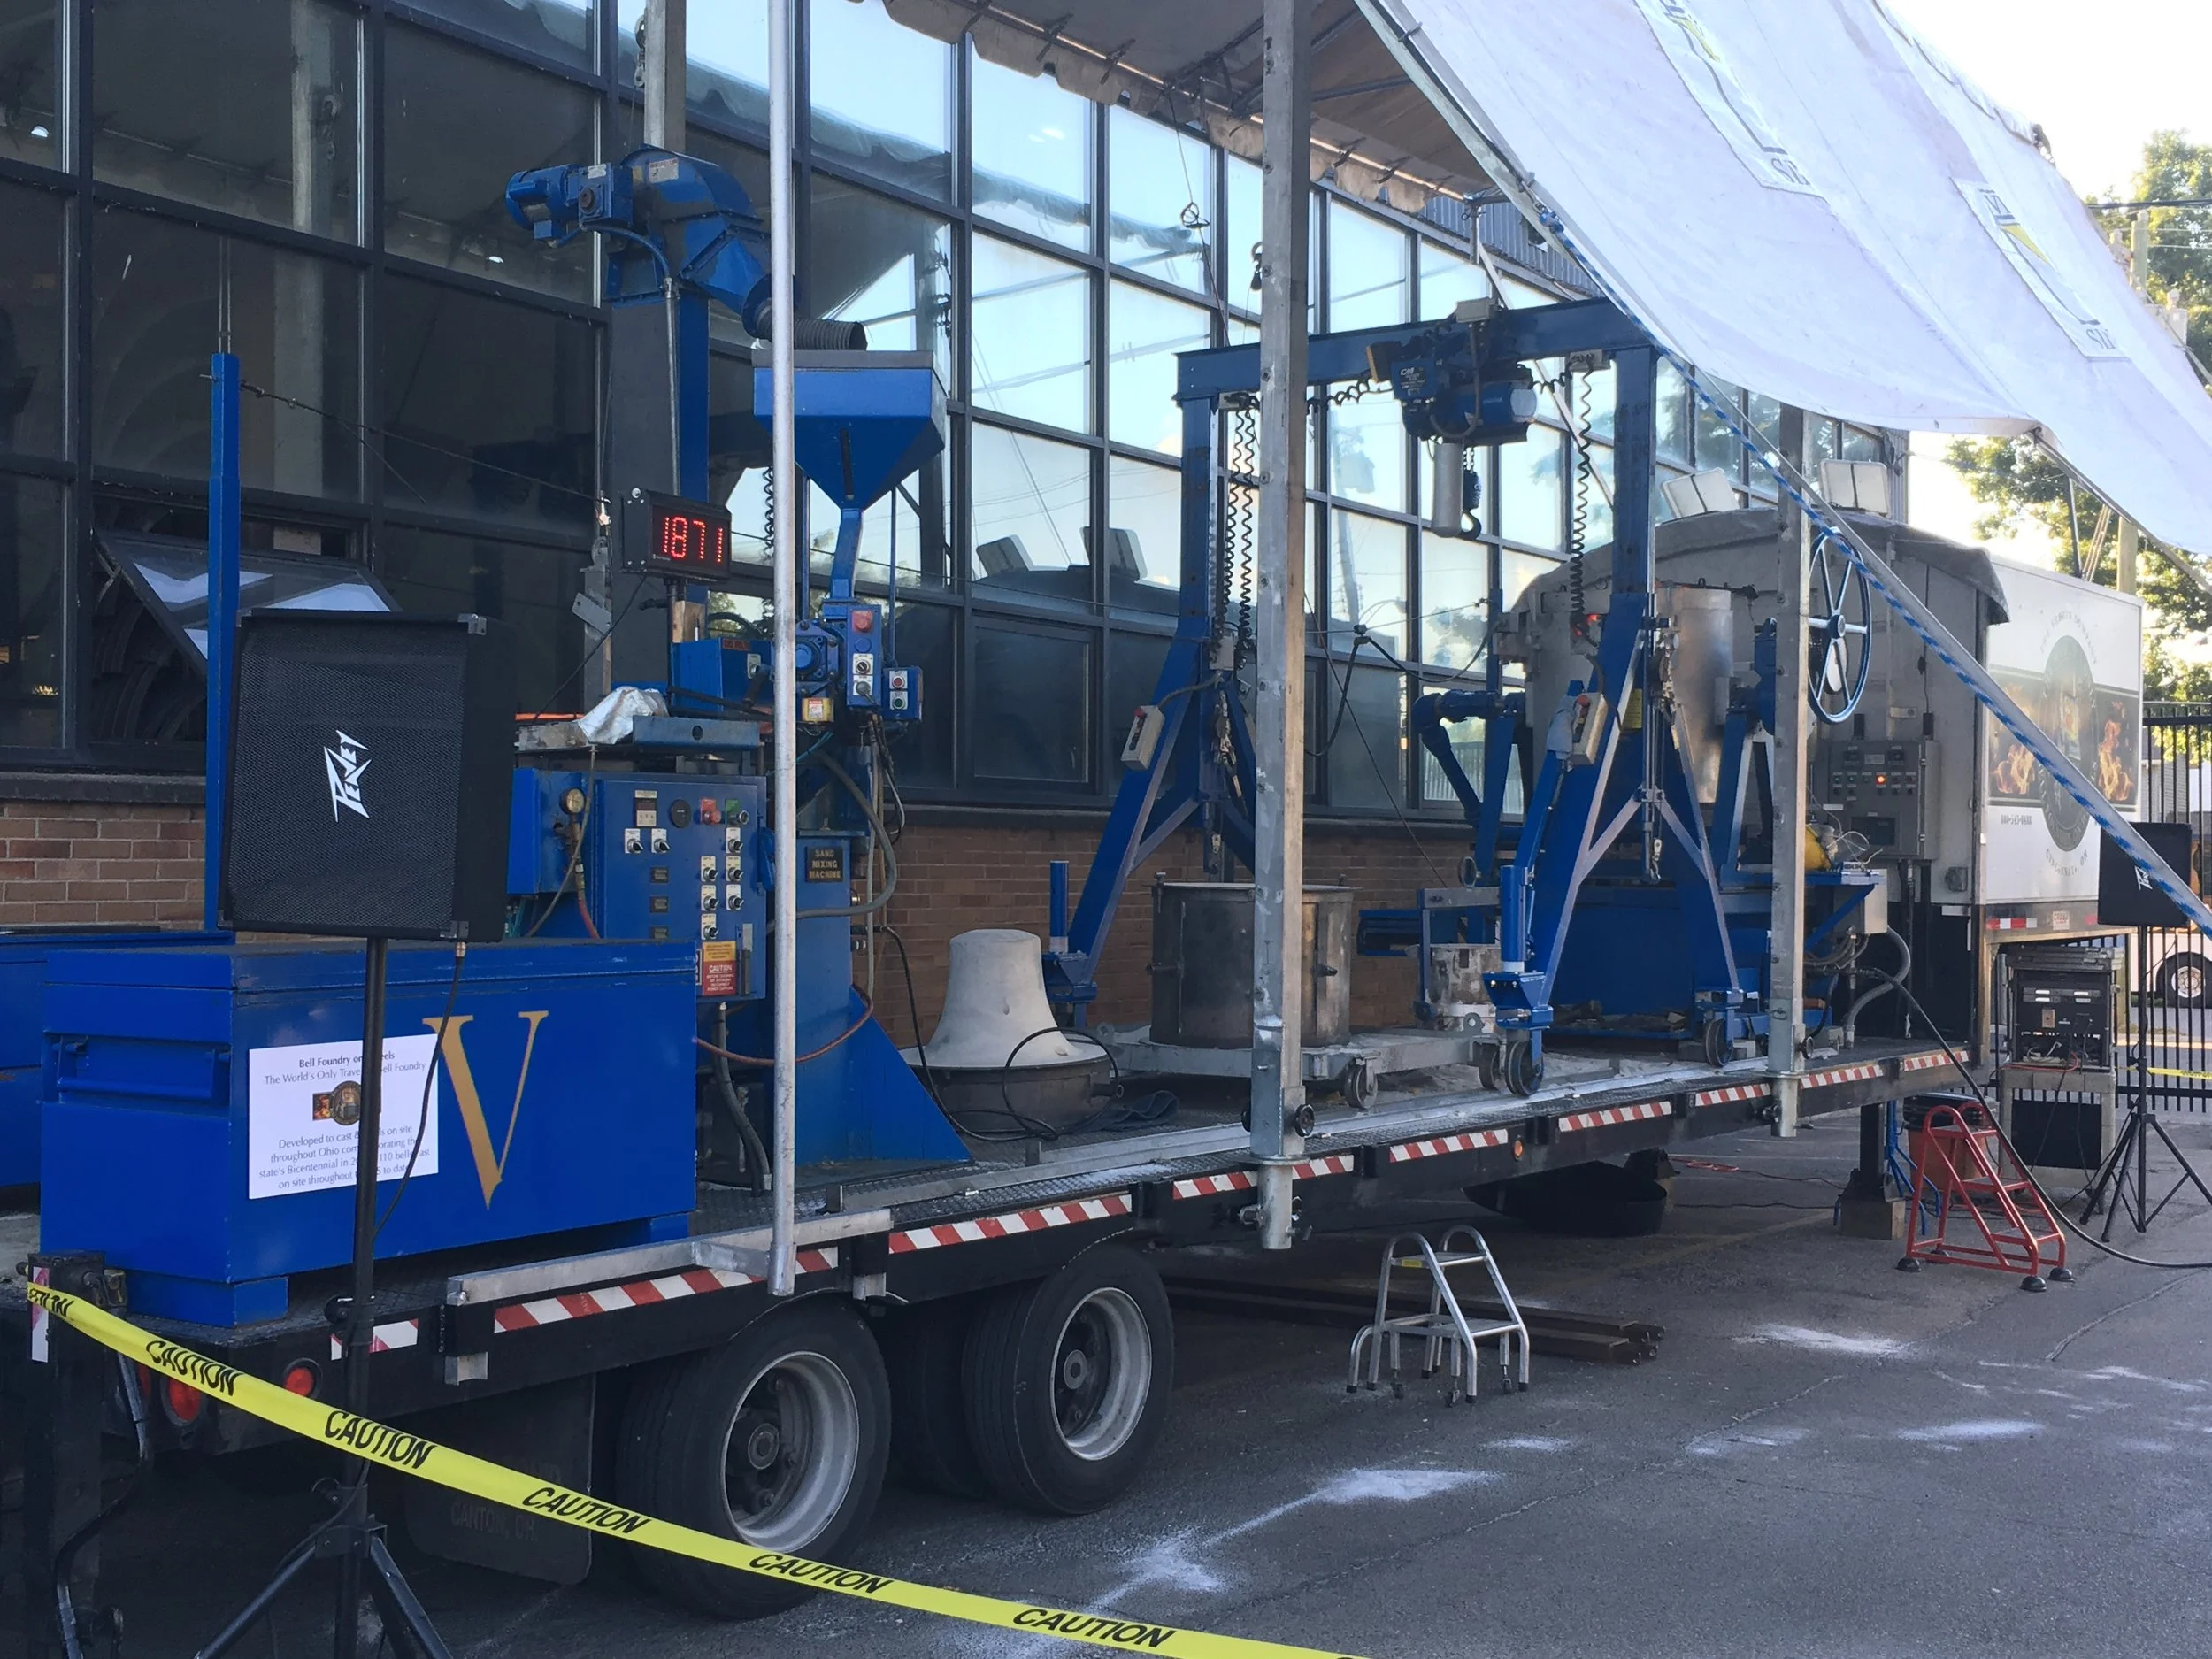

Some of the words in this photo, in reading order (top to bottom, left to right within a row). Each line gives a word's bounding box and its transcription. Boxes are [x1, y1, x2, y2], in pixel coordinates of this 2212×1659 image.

[664, 516, 724, 564] 1871
[809, 870, 841, 879] MACHINE
[812, 860, 838, 869] MIXING
[265, 1075, 280, 1085] The
[282, 1071, 315, 1083] World's
[317, 1069, 337, 1080] Only
[382, 1063, 392, 1073] ell
[395, 1061, 426, 1072] Foundry
[299, 1057, 315, 1068] Bell
[318, 1055, 350, 1067] Foundry
[422, 1010, 549, 1211] V
[279, 1134, 324, 1149] Developed
[336, 1133, 352, 1142] cast
[399, 1125, 412, 1133] site
[259, 1167, 285, 1179] state's
[287, 1158, 338, 1174] Bicentennial
[341, 1159, 349, 1168] in
[380, 1152, 393, 1162] 110
[417, 1148, 430, 1157] ast
[270, 1149, 316, 1164] throughout
[319, 1147, 339, 1157] Ohio
[278, 1180, 290, 1189] on
[292, 1178, 306, 1187] site
[308, 1171, 352, 1185] throughout
[383, 1166, 392, 1175] to
[146, 1340, 244, 1396] CAUTION
[323, 1409, 436, 1470] CAUTION
[522, 1486, 648, 1534] CAUTION
[749, 1553, 894, 1594] CAUTION
[1013, 1609, 1178, 1648] CAUTION
